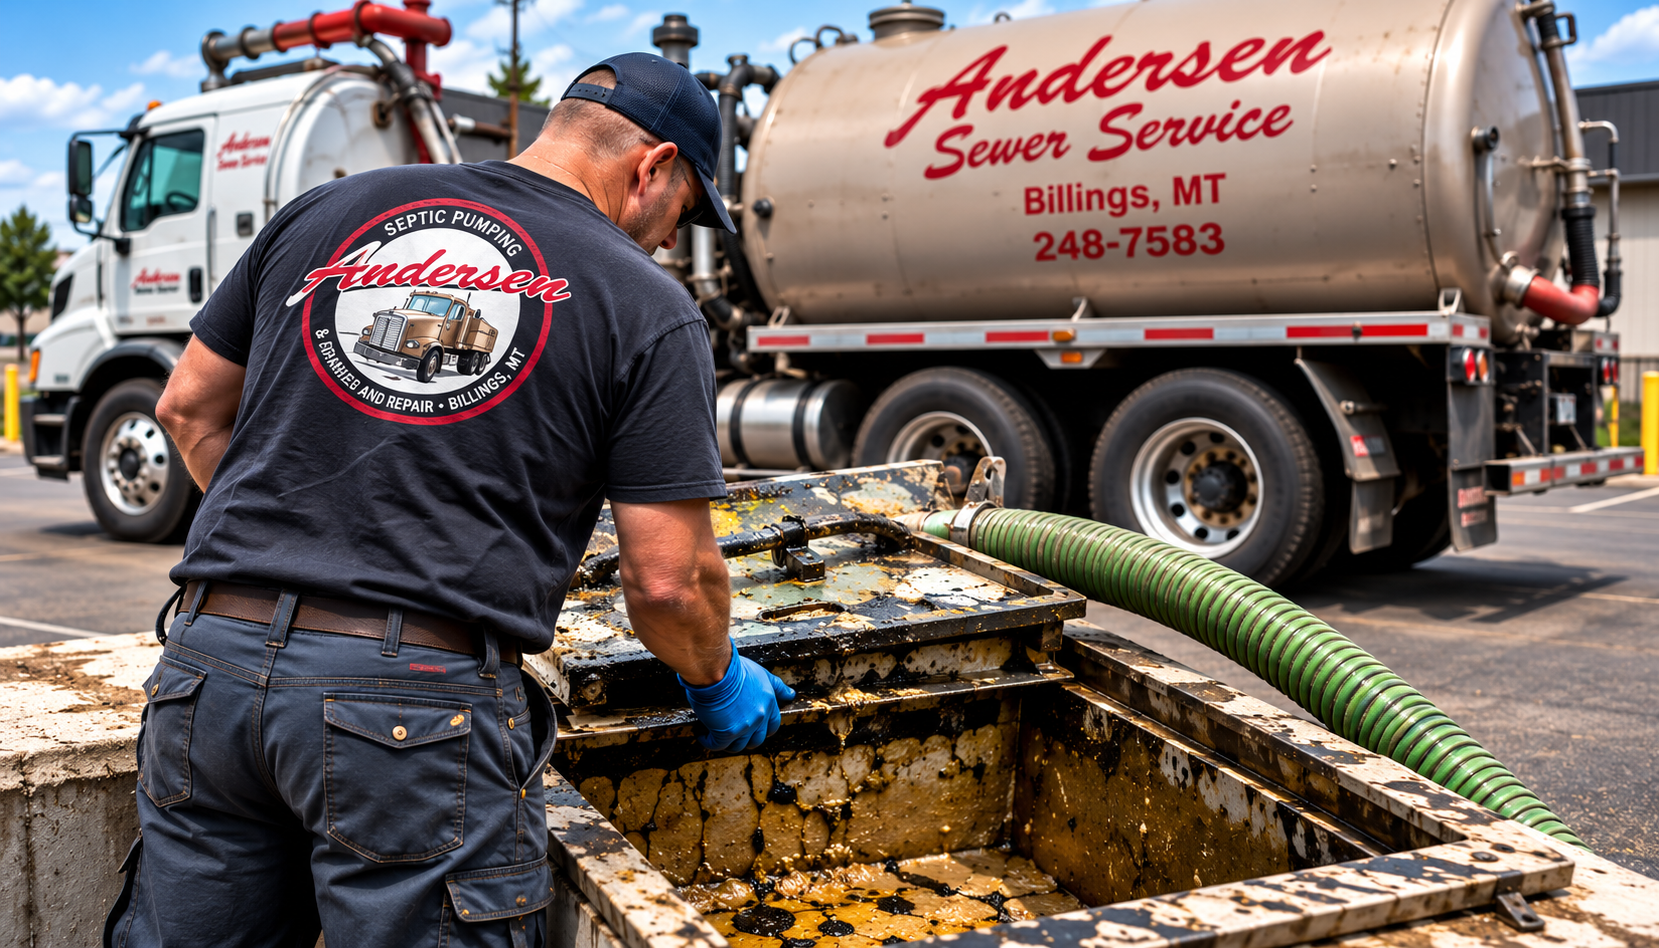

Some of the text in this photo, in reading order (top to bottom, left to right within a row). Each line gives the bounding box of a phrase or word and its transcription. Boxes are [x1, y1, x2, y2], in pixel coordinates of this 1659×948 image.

[884, 30, 1332, 148] Andersen
[924, 99, 1293, 180] Sewer Service
[1024, 173, 1226, 217] Billings, MT
[384, 209, 523, 257] SEPTIC PUMPING
[1033, 223, 1226, 262] 248-7583
[286, 241, 571, 306] Andersen
[357, 385, 385, 405] AND
[386, 396, 434, 413] REPAIR
[448, 371, 513, 410] BILLINGS,
[505, 347, 526, 371] MT
